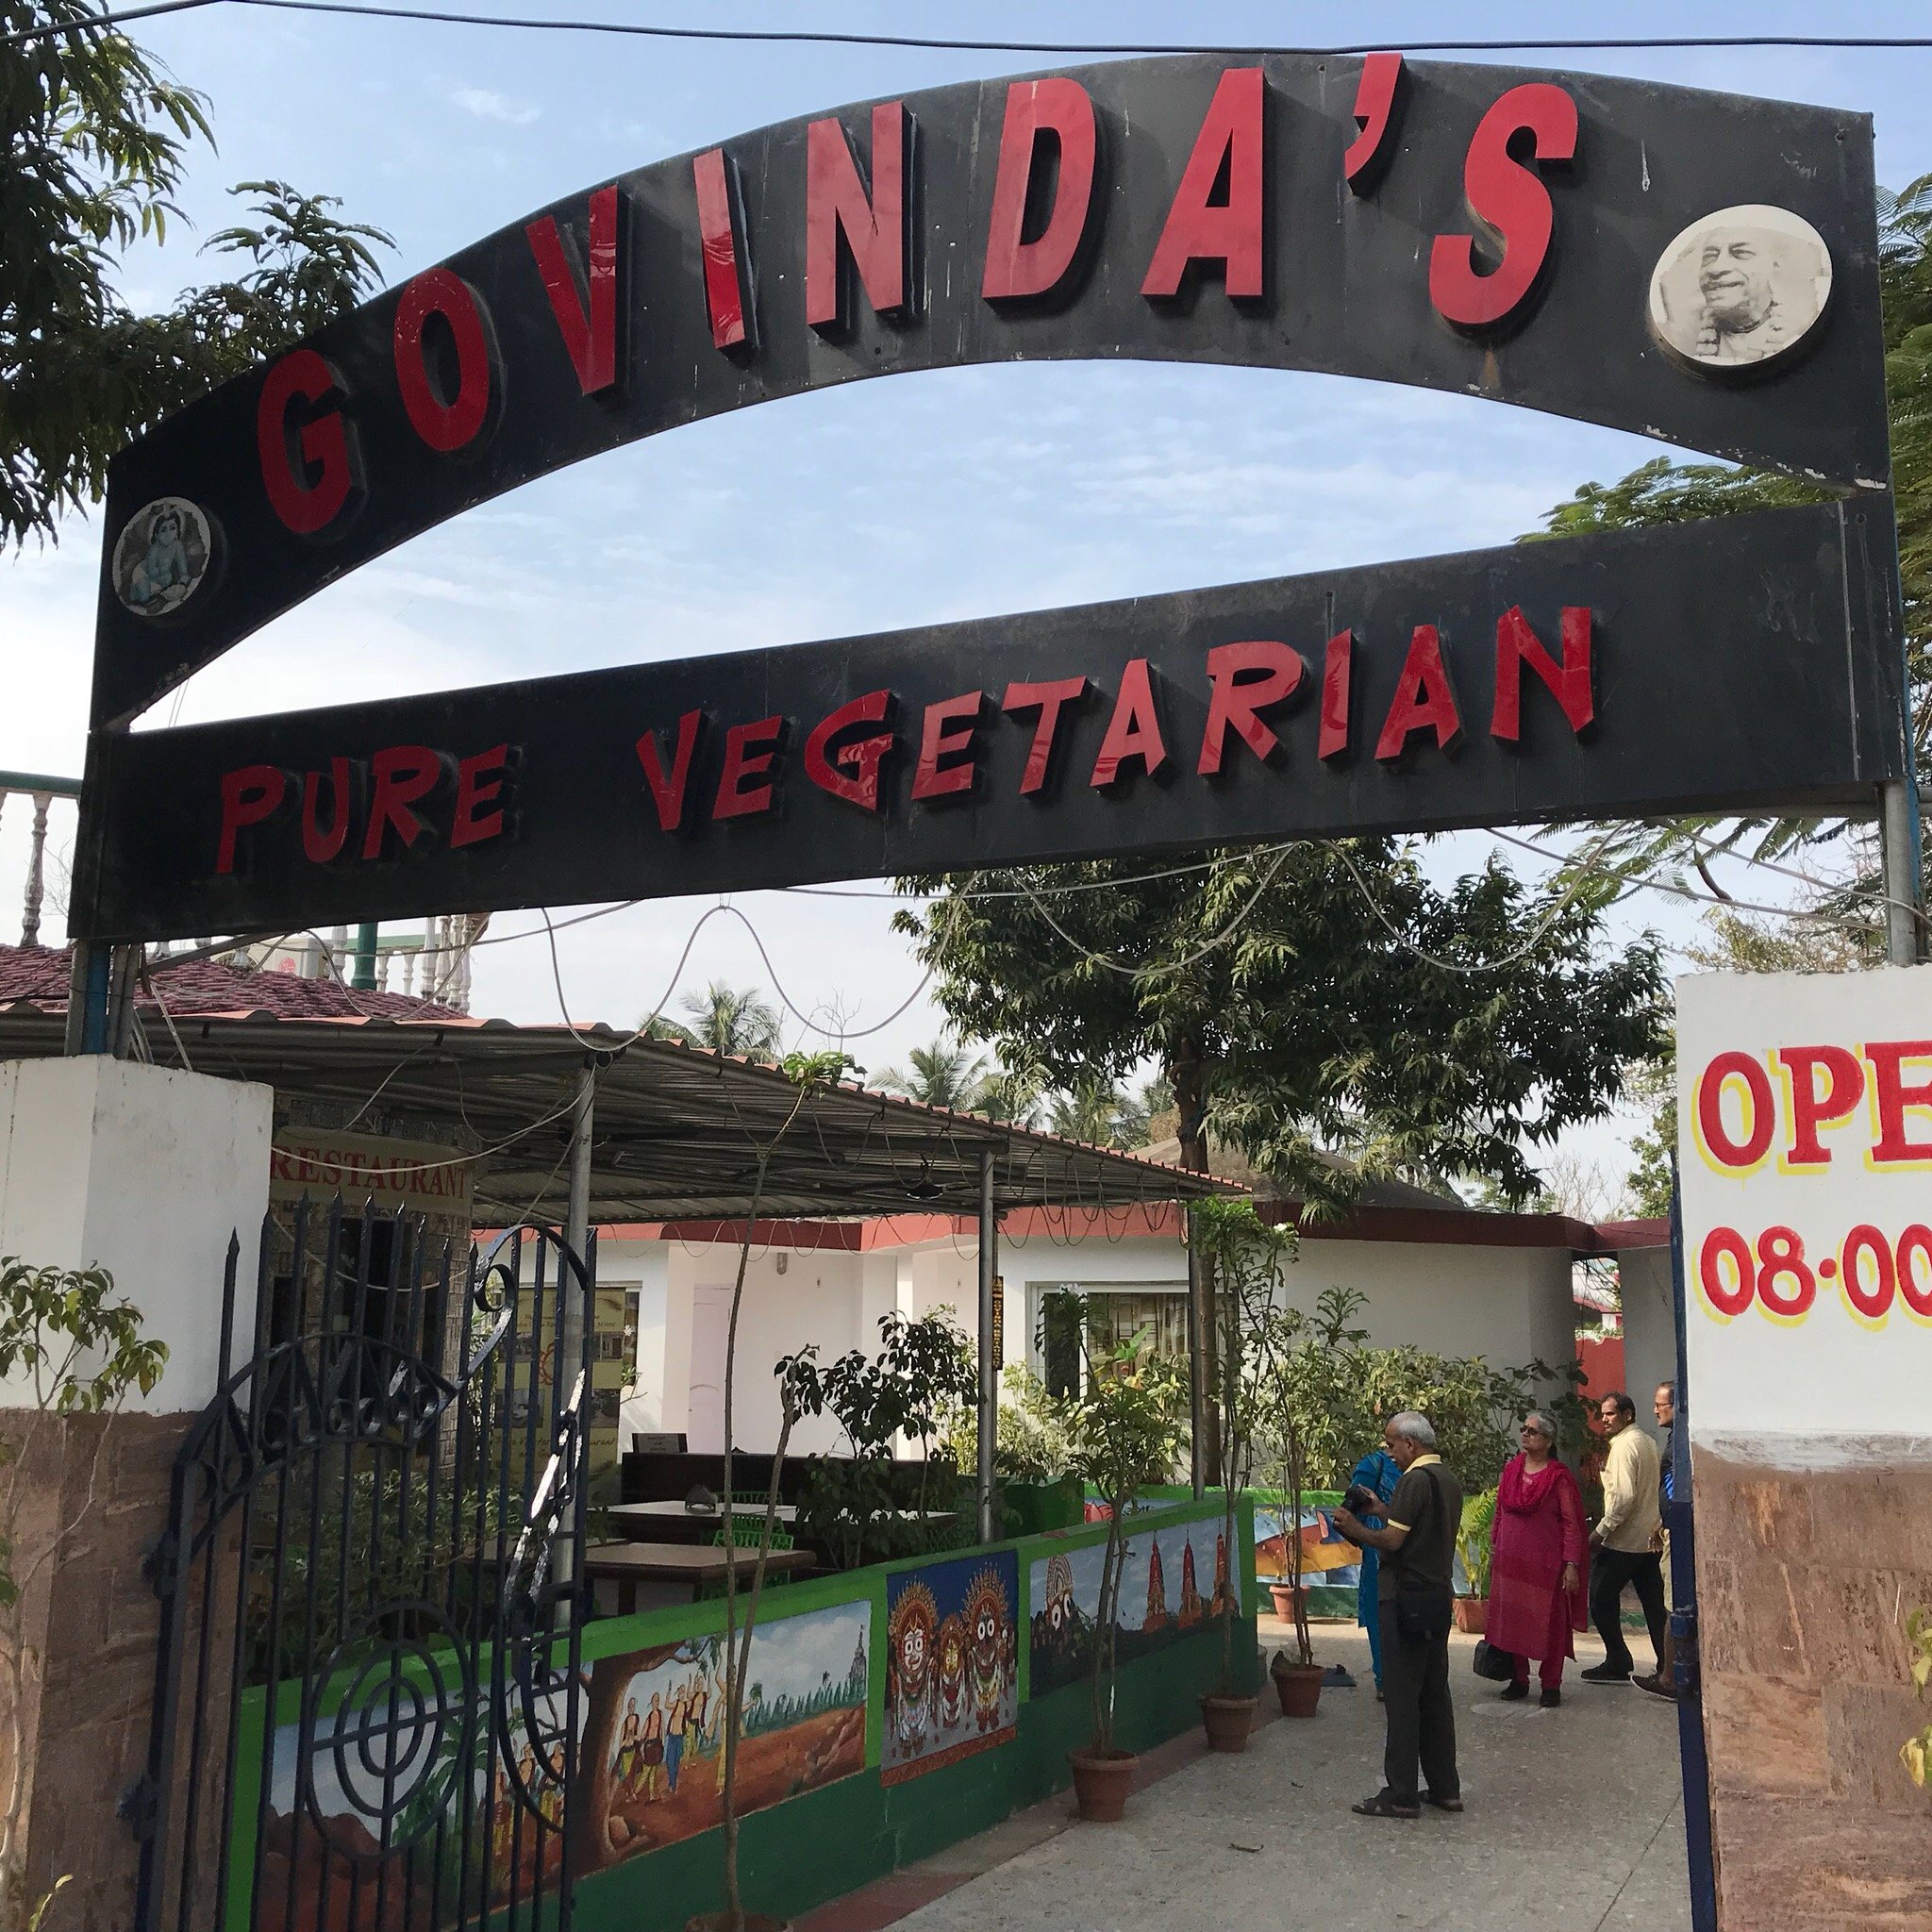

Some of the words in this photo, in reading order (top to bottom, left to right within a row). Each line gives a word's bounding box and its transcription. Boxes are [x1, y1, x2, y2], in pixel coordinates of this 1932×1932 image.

[258, 53, 1579, 534] GOVINDA'S
[217, 743, 508, 874] PURE
[636, 606, 1596, 832] VEGETARIAN
